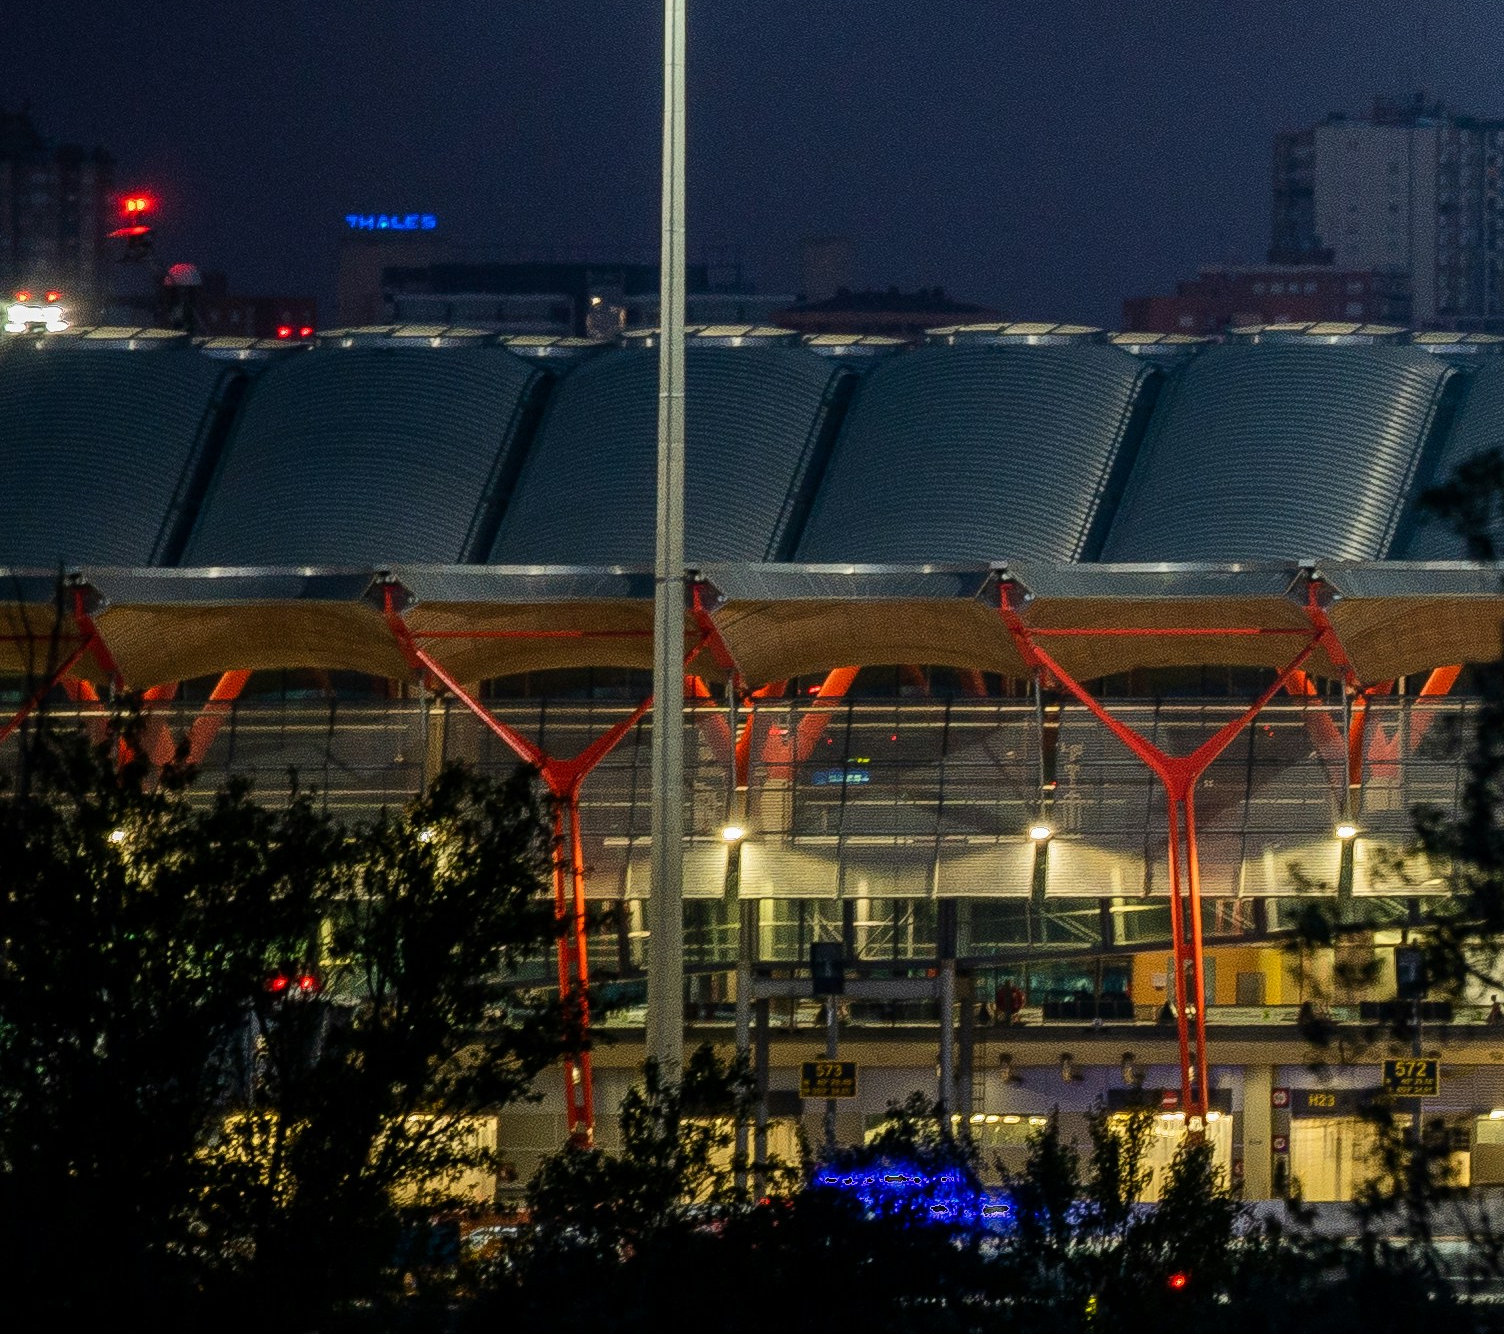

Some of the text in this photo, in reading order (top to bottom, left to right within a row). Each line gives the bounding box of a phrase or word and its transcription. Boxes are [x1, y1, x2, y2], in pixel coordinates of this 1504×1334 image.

[344, 213, 439, 231] THALES
[816, 1064, 842, 1077] 573
[1395, 1061, 1427, 1077] 572
